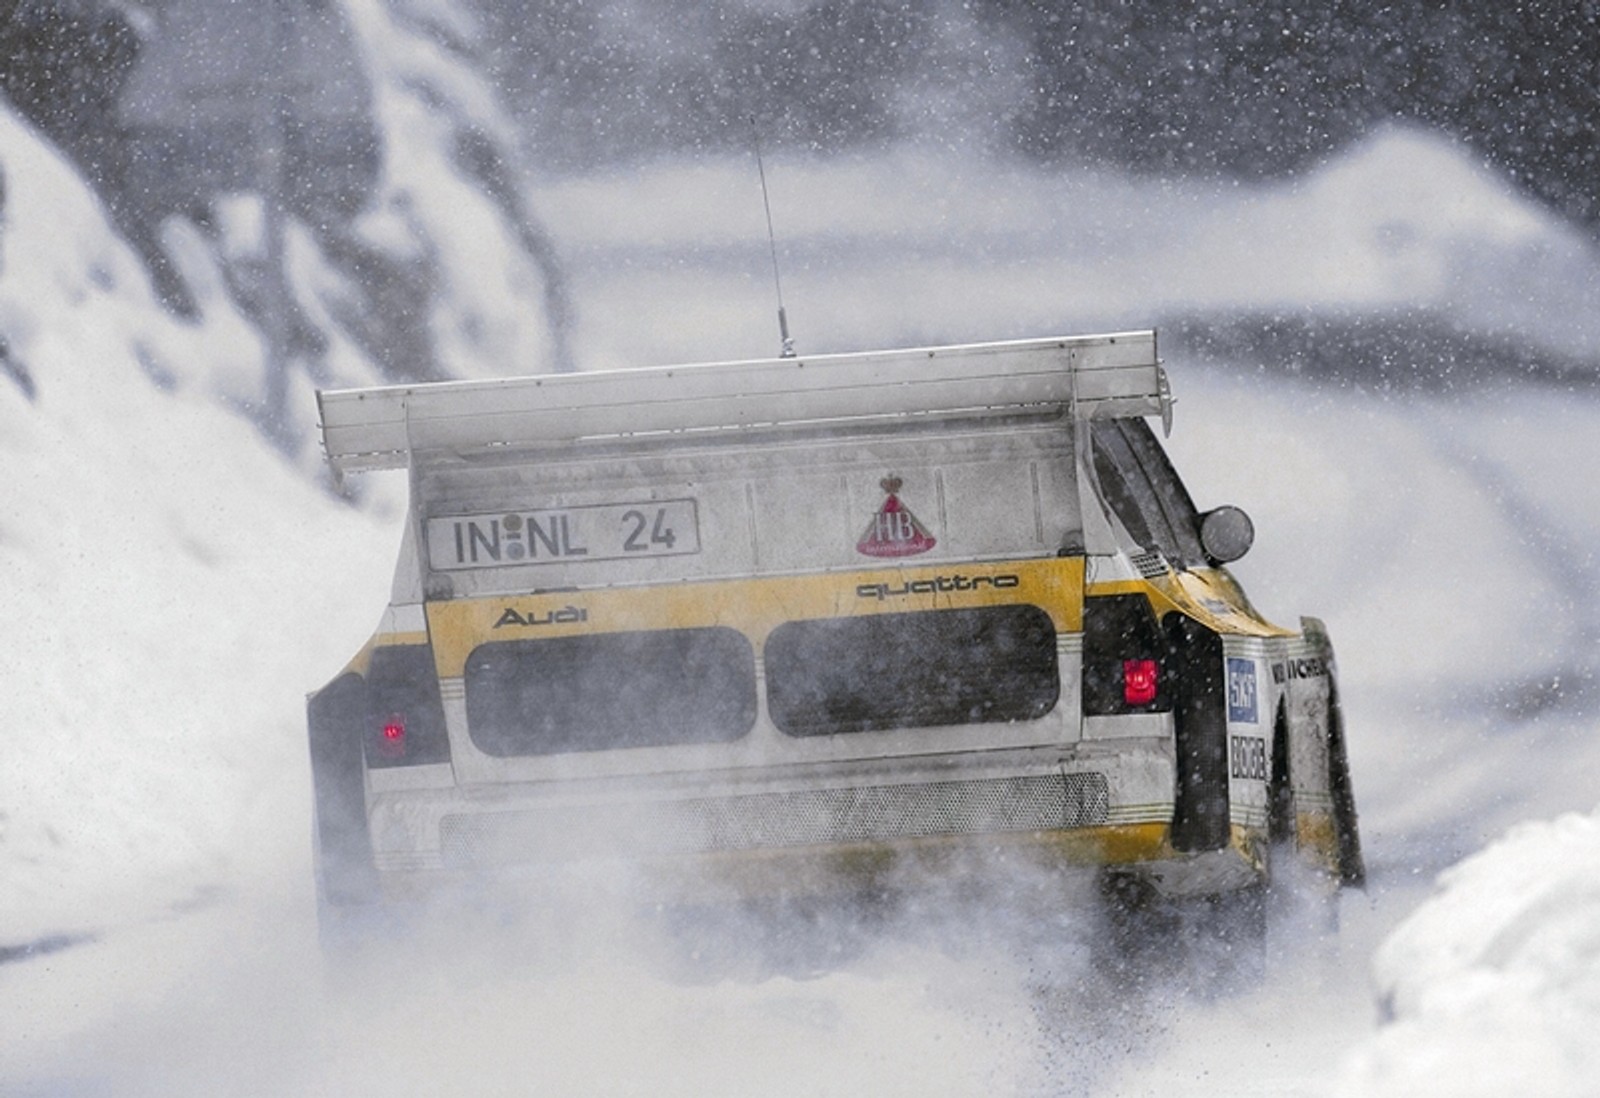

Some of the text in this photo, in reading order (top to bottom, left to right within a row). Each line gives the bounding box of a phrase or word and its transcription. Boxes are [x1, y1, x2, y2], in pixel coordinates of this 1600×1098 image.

[621, 509, 676, 552] 24
[872, 511, 914, 541] HB
[856, 574, 1019, 601] quattro
[493, 606, 588, 629] Audi
[1230, 672, 1255, 708] SKF
